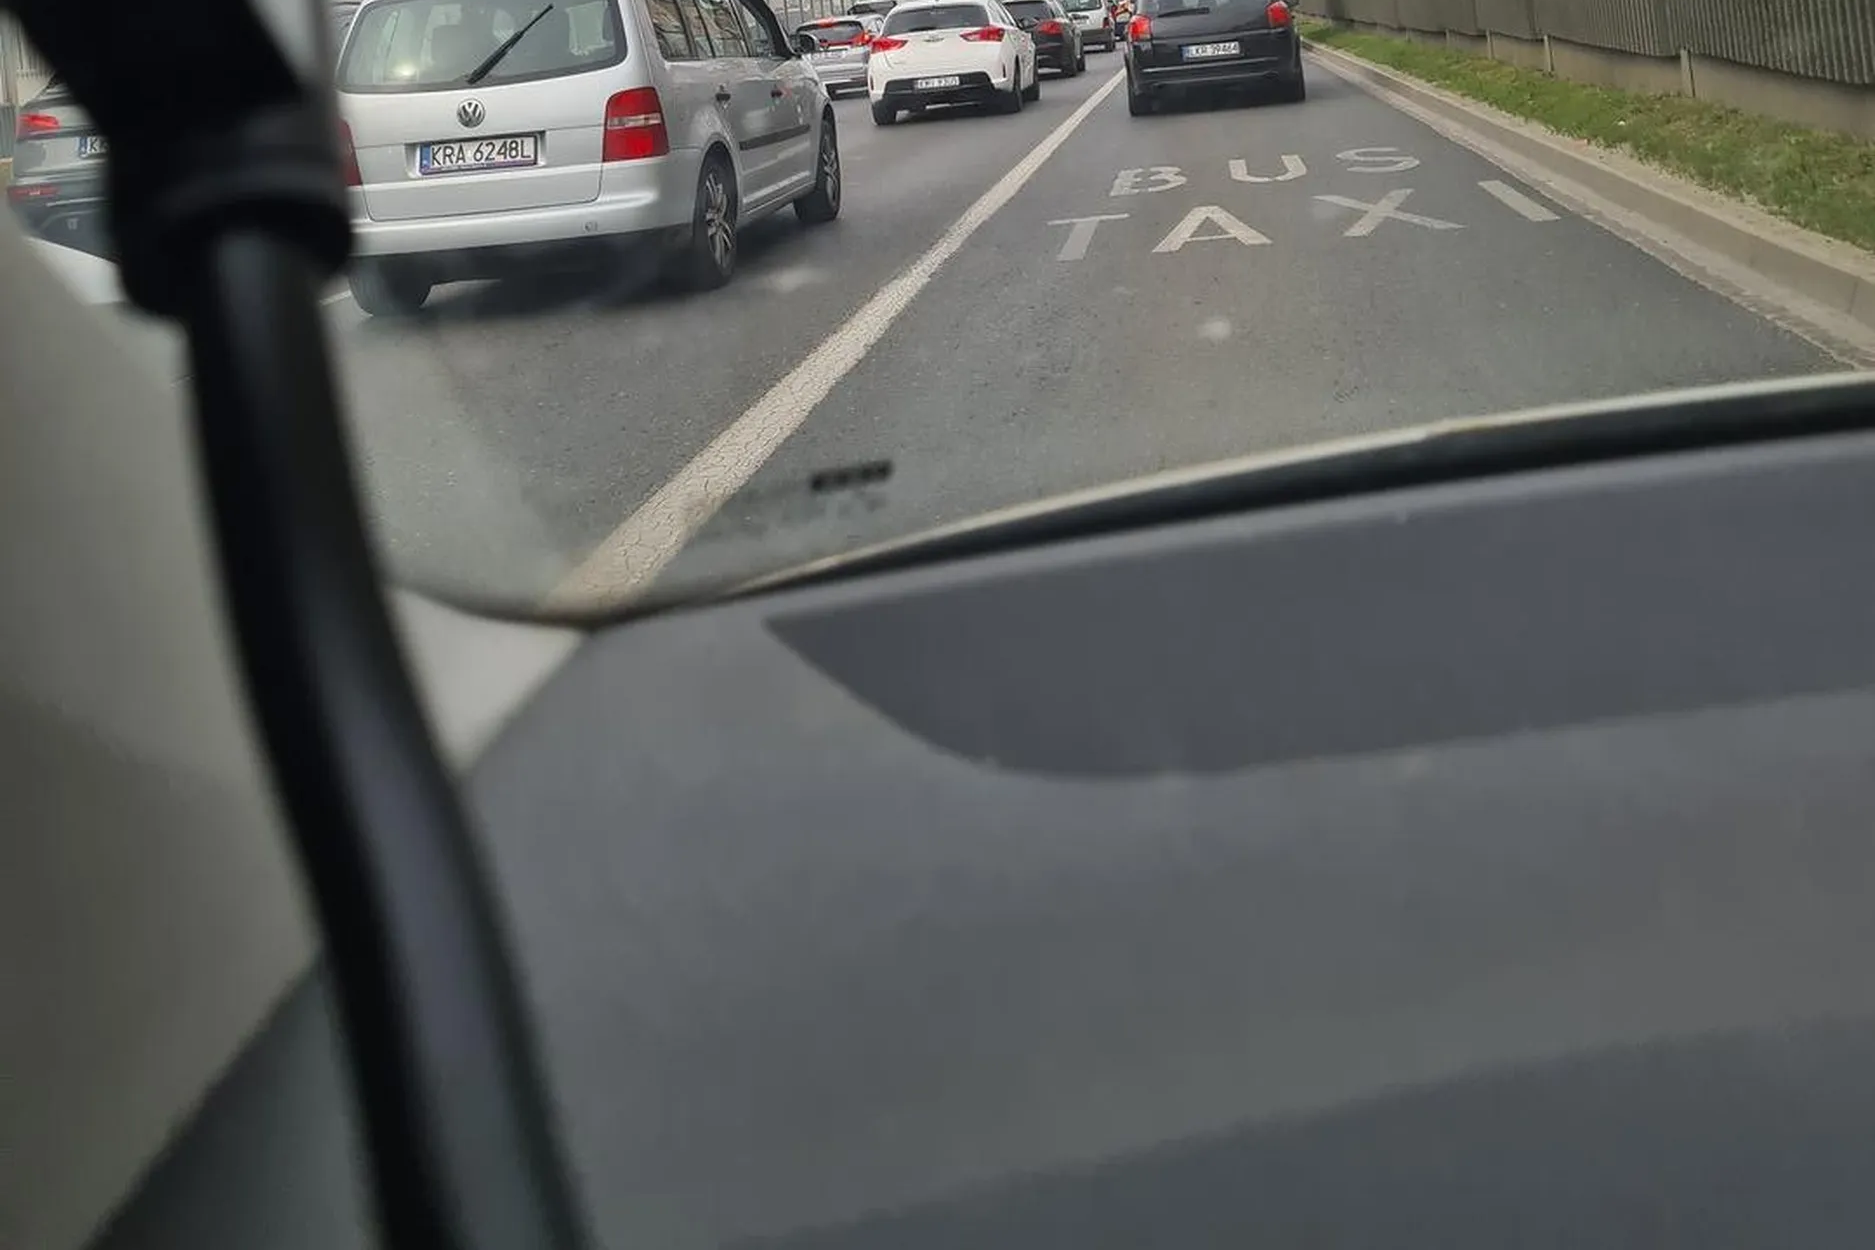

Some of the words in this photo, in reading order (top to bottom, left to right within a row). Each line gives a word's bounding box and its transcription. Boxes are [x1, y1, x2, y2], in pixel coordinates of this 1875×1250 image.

[431, 144, 466, 166] KRA
[473, 139, 531, 162] 6248L
[1109, 147, 1420, 197] BUS
[1047, 179, 1560, 261] TAXI
